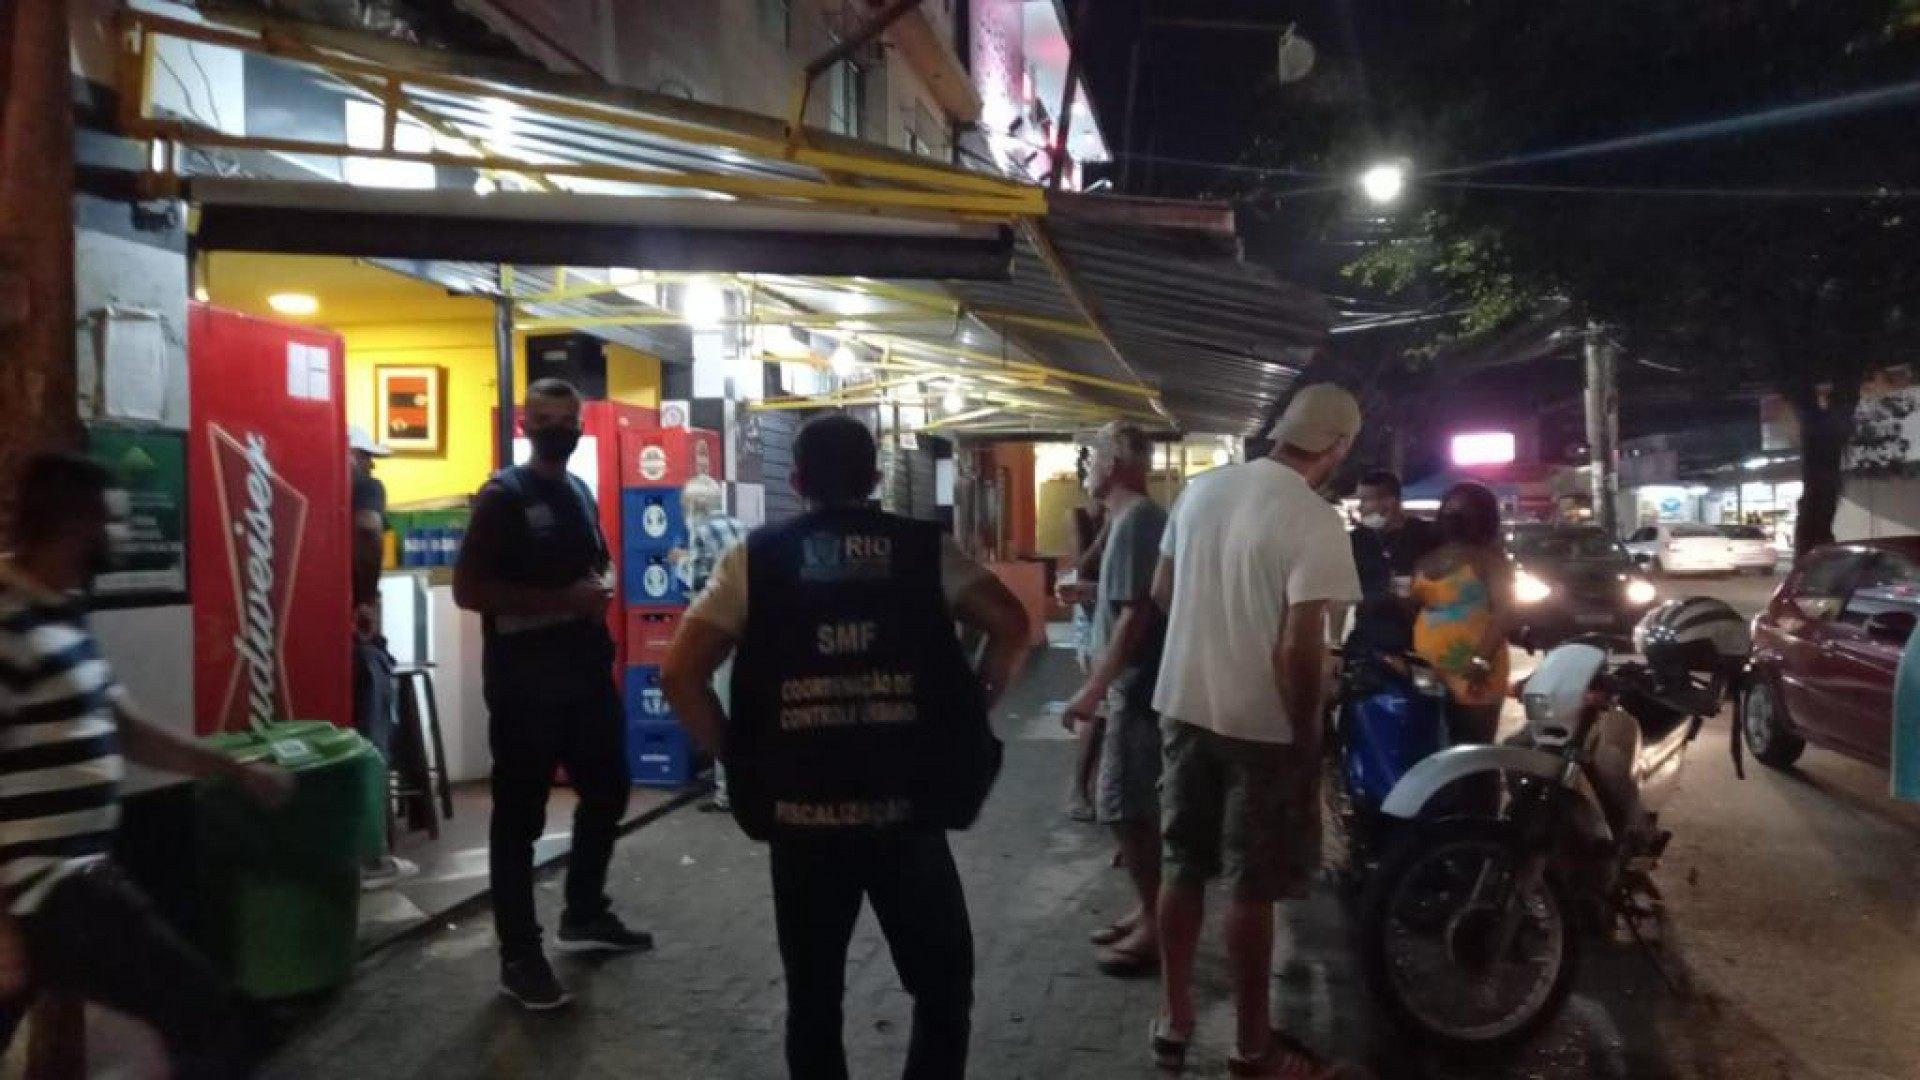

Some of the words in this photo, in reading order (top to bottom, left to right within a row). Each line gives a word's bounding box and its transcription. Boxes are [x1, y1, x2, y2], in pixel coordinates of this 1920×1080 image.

[846, 534, 892, 556] RIO
[234, 431, 276, 734] udweiser
[818, 622, 876, 654] SMF
